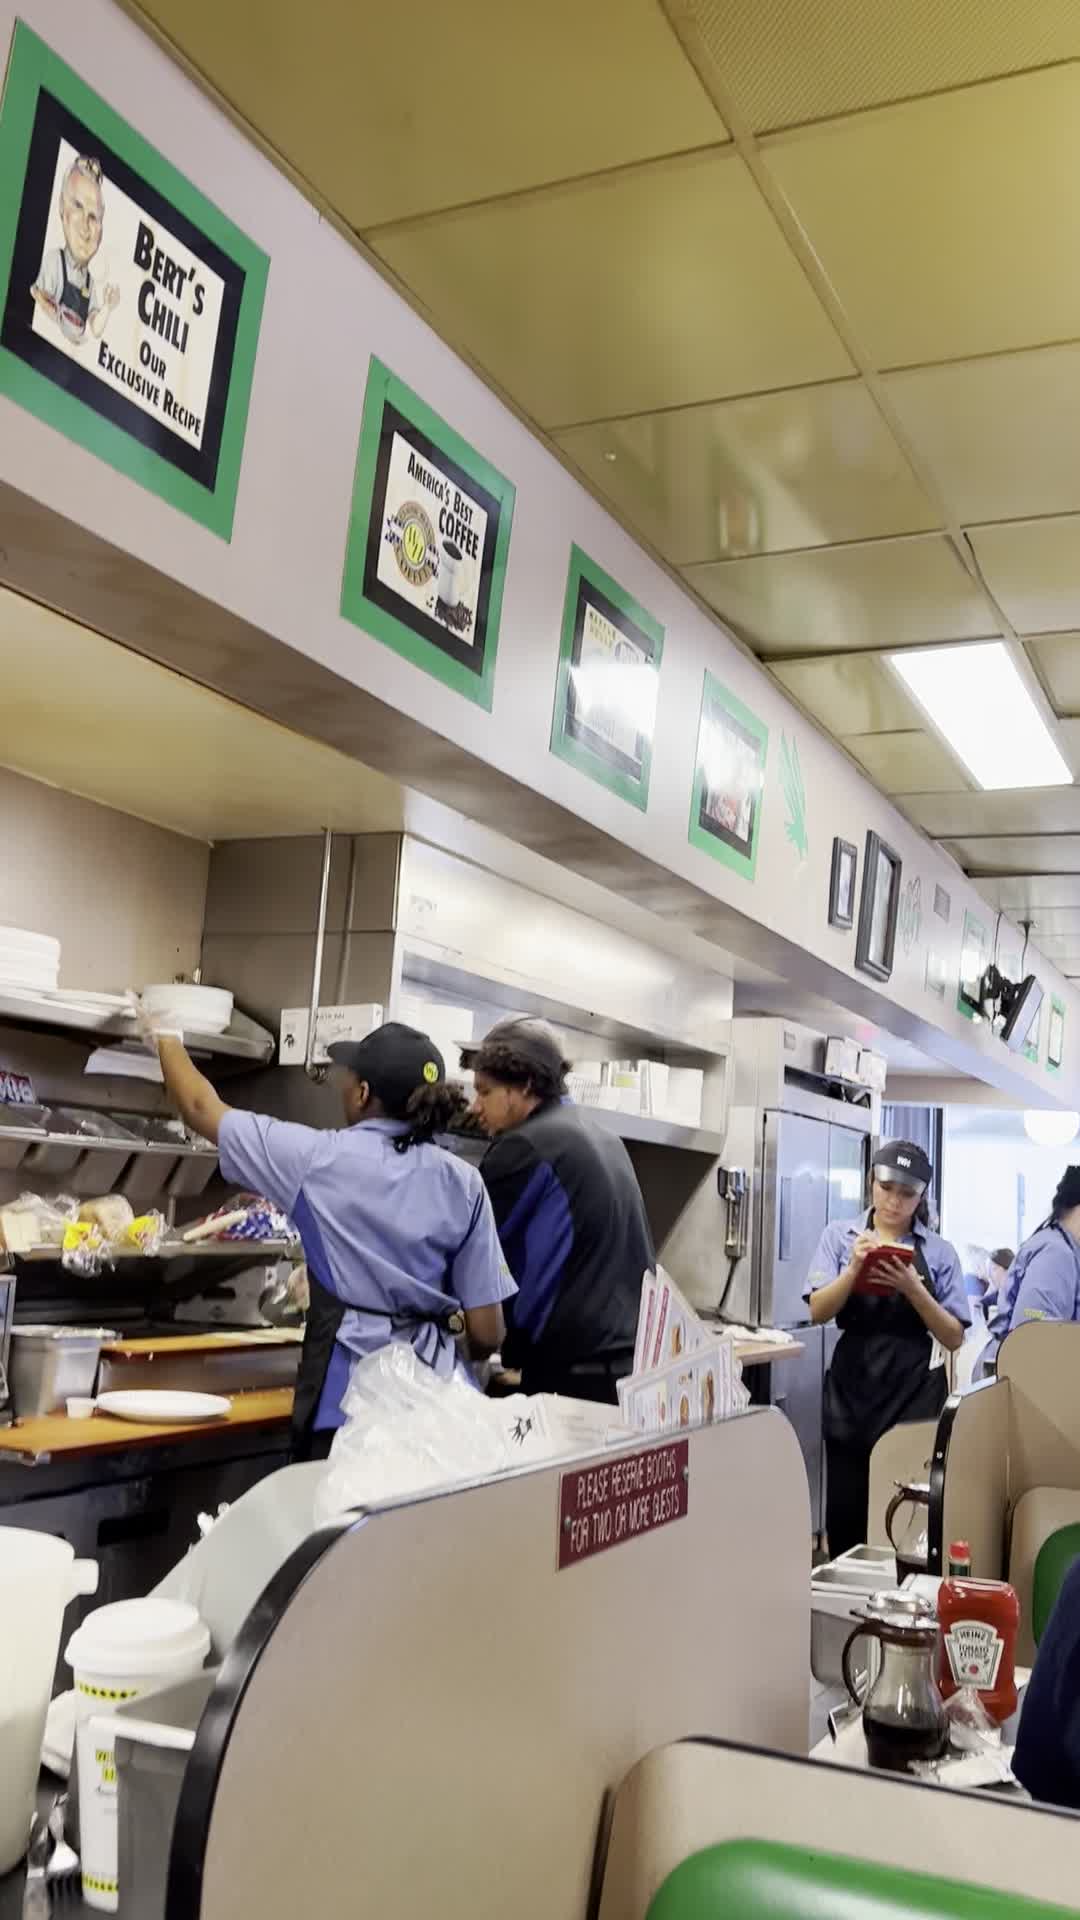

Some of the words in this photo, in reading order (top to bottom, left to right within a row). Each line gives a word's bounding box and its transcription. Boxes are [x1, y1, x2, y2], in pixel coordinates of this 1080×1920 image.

[133, 220, 205, 316] BERT'S
[138, 280, 189, 355] CHILI
[98, 340, 160, 406] EXCLUSIVE
[162, 388, 201, 437] RECIPE
[139, 341, 166, 381] OUR
[407, 452, 451, 507] AMERICA'S
[453, 491, 473, 526] BEST
[439, 507, 479, 561] COFFEE
[577, 1467, 608, 1509] PLEASE
[611, 1457, 644, 1497] RESERVE
[646, 1449, 676, 1487] BOOTHS
[570, 1516, 590, 1553] FOR
[592, 1507, 612, 1544] TWO
[615, 1502, 627, 1537] OR
[628, 1494, 650, 1531] MORE
[652, 1483, 680, 1523] GUESTS
[960, 1630, 985, 1640] HEINZ
